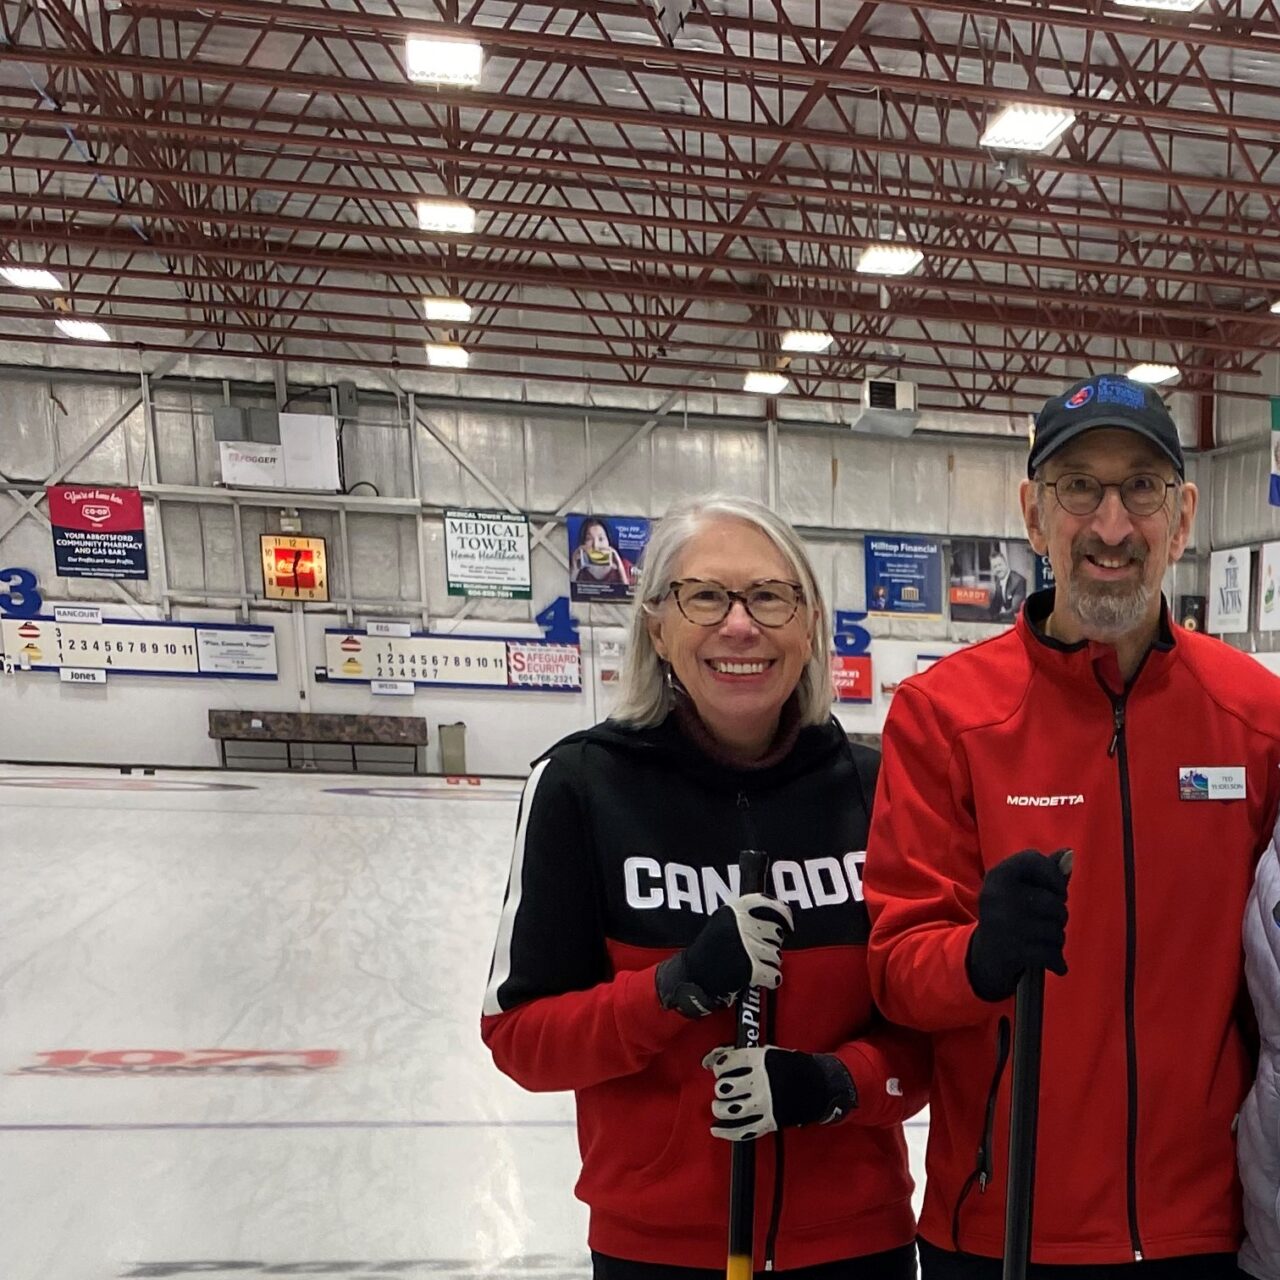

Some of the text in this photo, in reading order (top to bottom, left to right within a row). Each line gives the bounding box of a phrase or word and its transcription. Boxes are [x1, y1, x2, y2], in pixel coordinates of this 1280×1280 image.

[450, 521, 524, 537] MEDICAL
[64, 532, 133, 543] YOUR ABBOTSFORD
[56, 540, 143, 551] COMMUNITY PHARMACY
[457, 536, 517, 552] TOWER
[871, 541, 938, 553] Hilltop Financial
[74, 547, 91, 555] AND
[0, 568, 42, 616] 3
[535, 596, 580, 643] 4
[55, 627, 61, 638] 3
[834, 611, 871, 653] 5
[57, 639, 193, 655] 1 2 3 4 5 6 7 8 9 10 11
[106, 655, 112, 665] 4
[377, 653, 503, 669] 1 2 3 4 5 6 7 8 9 10 11
[6, 663, 12, 674] 2
[377, 668, 383, 677] 2
[400, 668, 406, 677] 4
[433, 669, 438, 679] 7
[71, 671, 96, 681] Jones
[1007, 794, 1085, 807] MONDETTA
